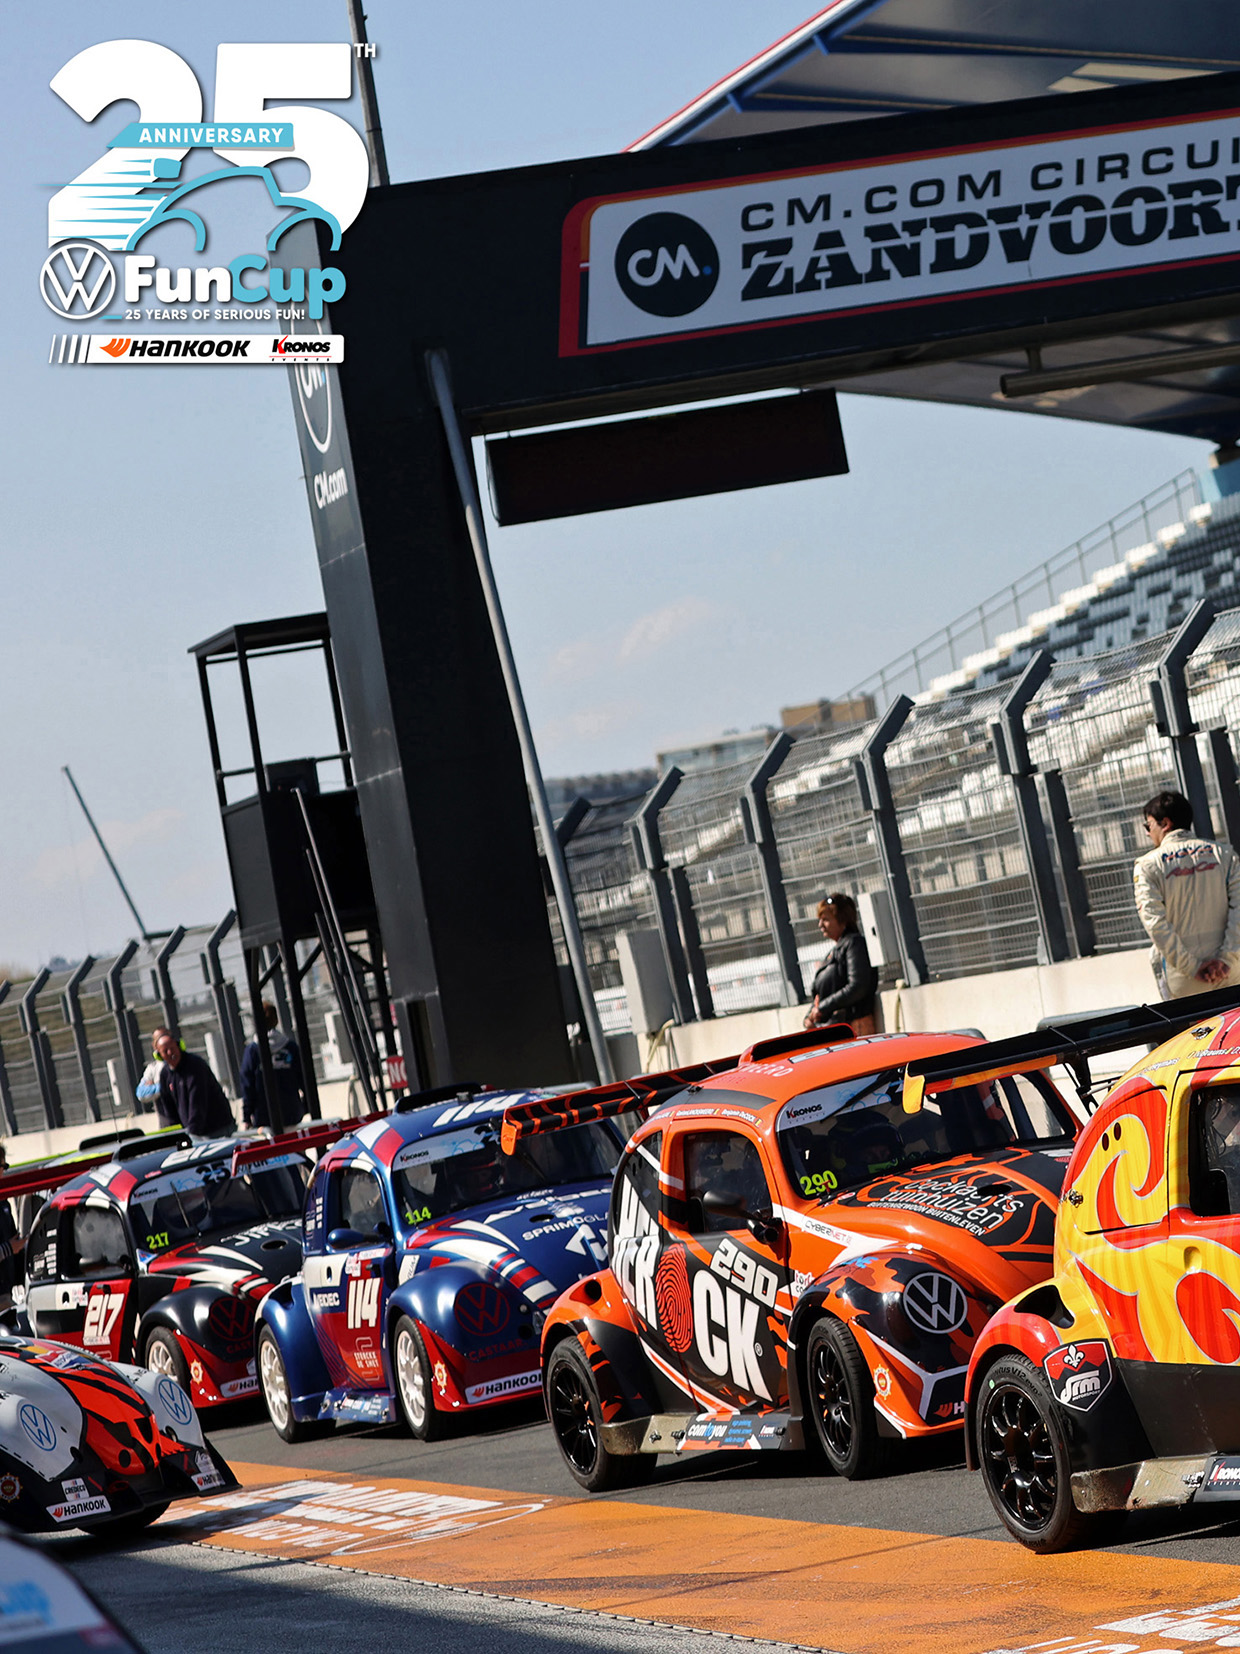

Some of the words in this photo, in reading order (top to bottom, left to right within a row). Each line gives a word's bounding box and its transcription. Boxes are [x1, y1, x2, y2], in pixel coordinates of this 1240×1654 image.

[740, 170, 1001, 233] CM.COM
[786, 1103, 823, 1119] KRONOS
[800, 1170, 838, 1195] 290
[405, 1207, 432, 1226] 114
[146, 1232, 170, 1249] 217
[709, 1238, 779, 1309] 290
[84, 1294, 125, 1338] 217
[348, 1278, 381, 1329] 114
[688, 1422, 727, 1440] comtoyou
